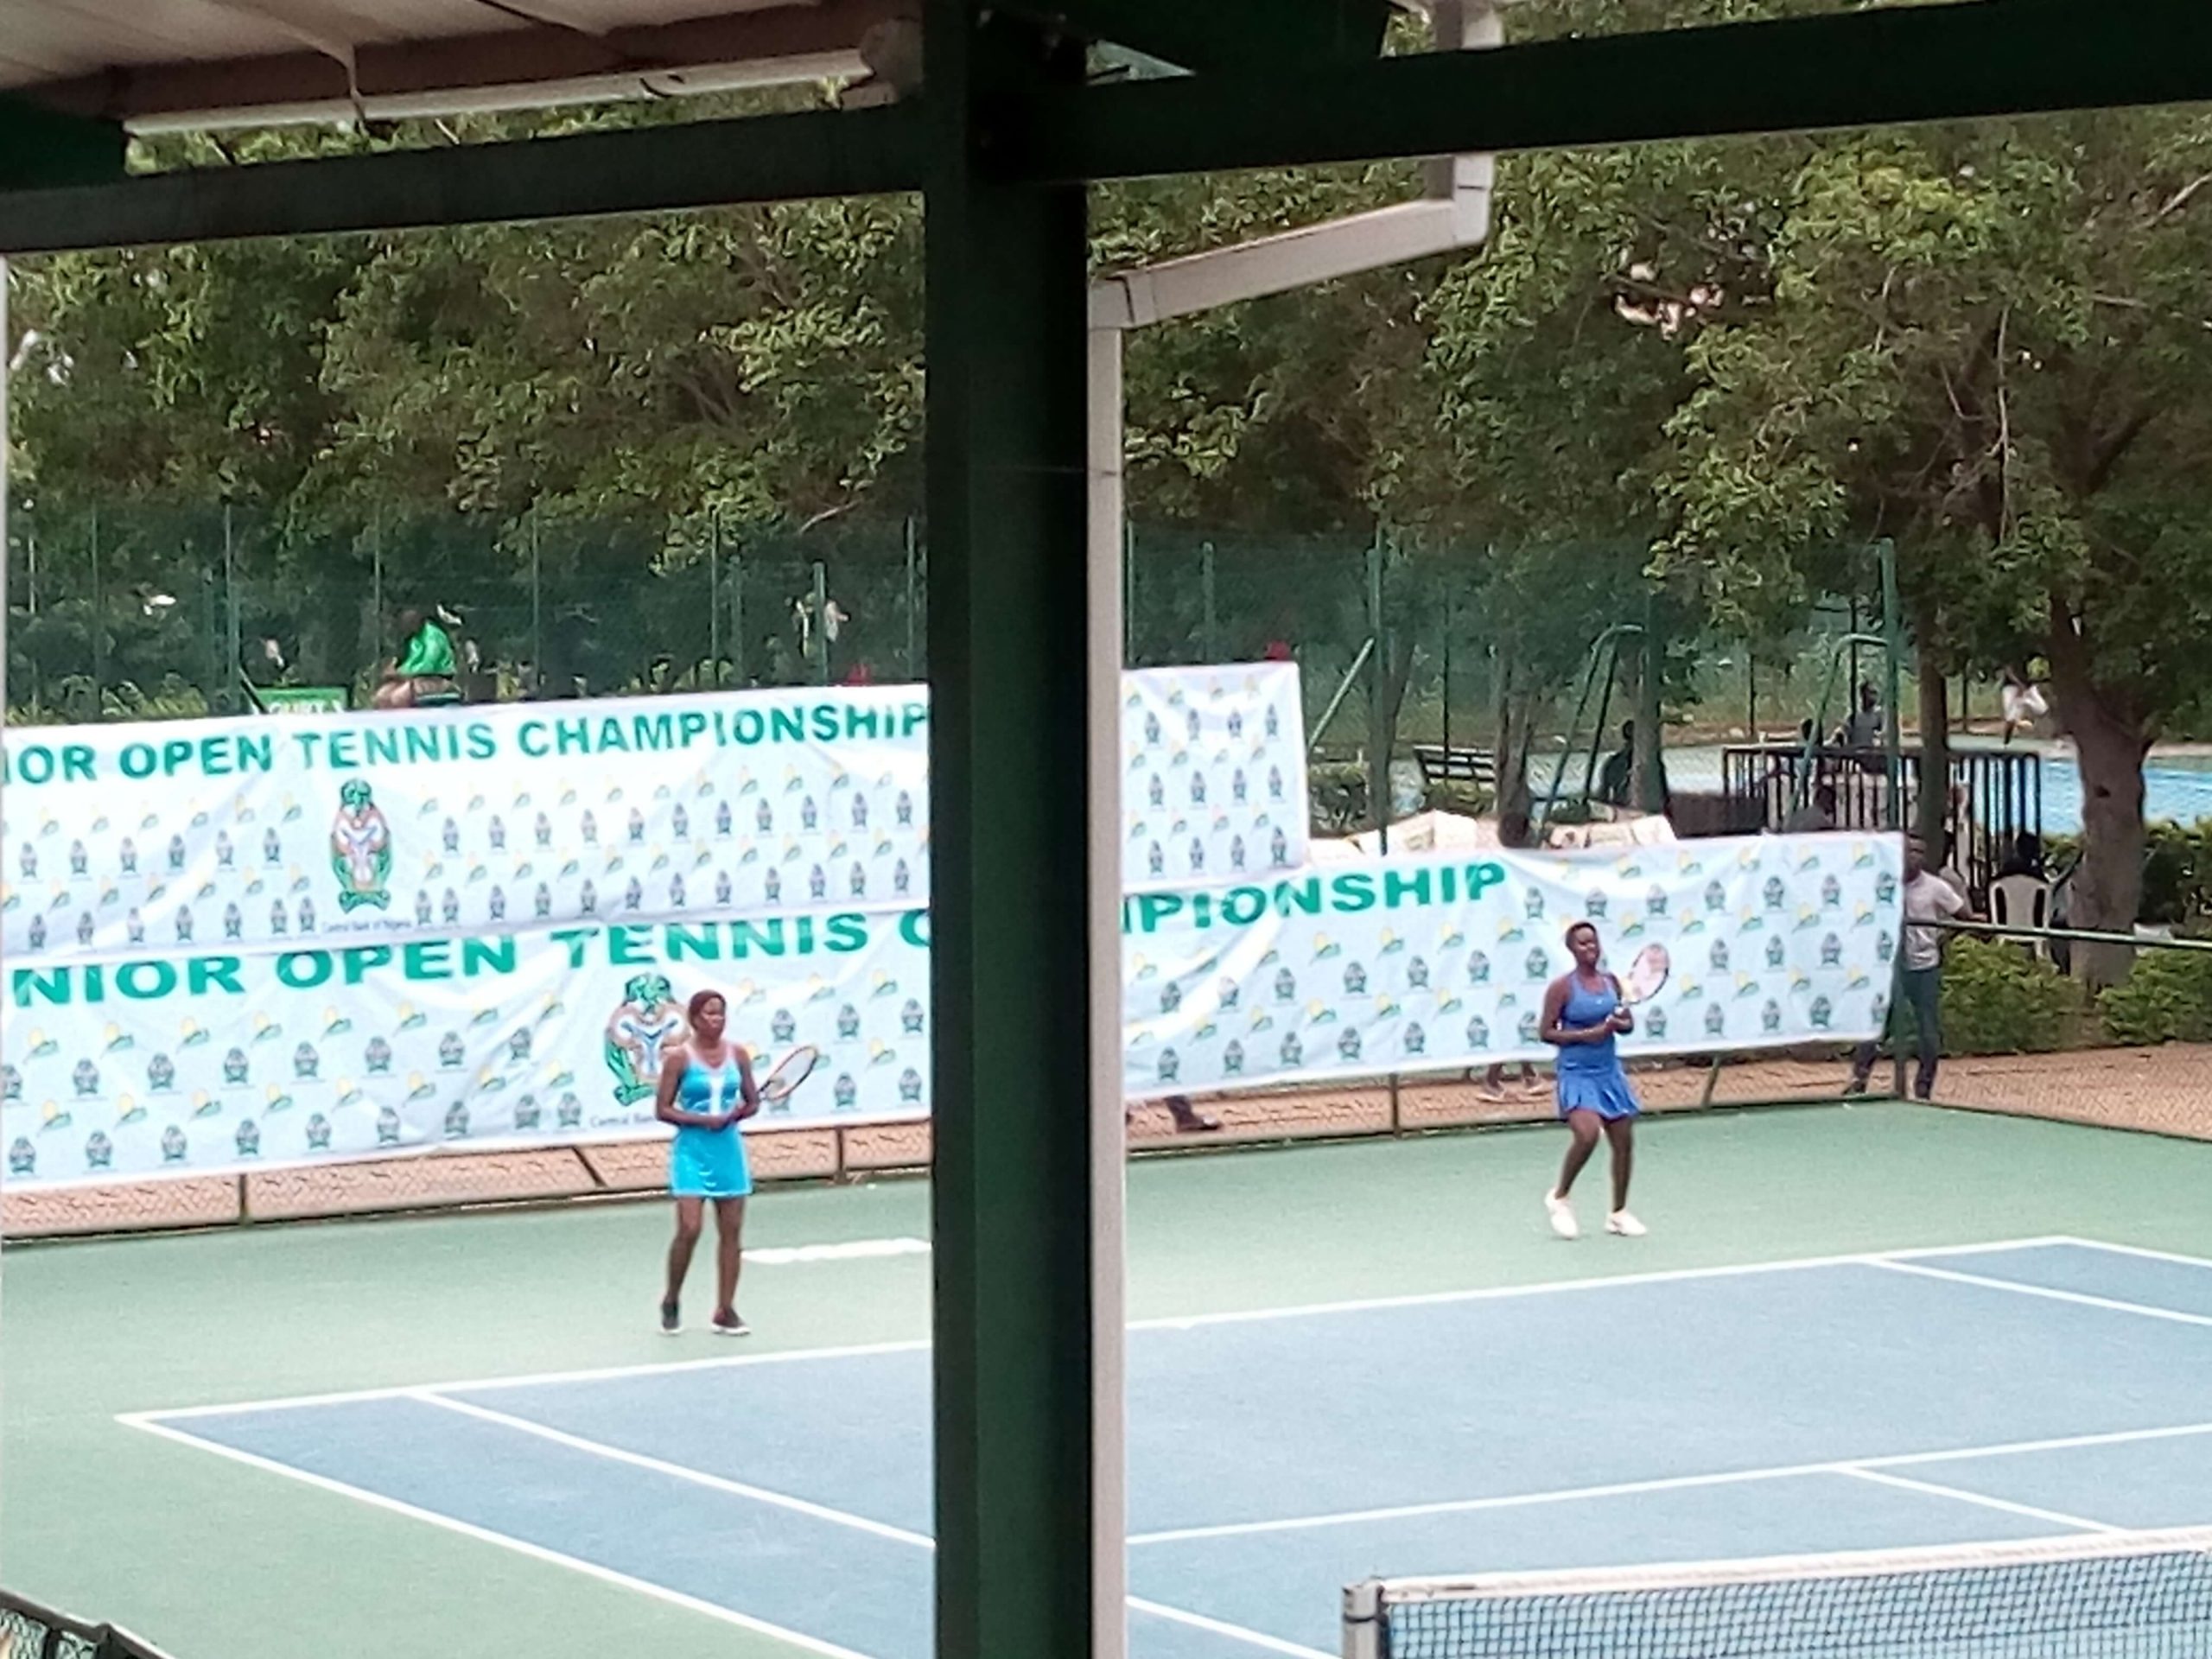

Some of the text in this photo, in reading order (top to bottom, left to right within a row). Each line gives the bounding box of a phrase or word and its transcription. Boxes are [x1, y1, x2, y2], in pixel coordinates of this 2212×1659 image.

[118, 735, 272, 779] OPEN
[294, 723, 496, 769] TENNIS
[518, 702, 928, 756] CHAMPIONSHIP
[12, 956, 245, 1007] NIOR
[276, 936, 516, 989] OPEN
[550, 912, 868, 969] TENNIS
